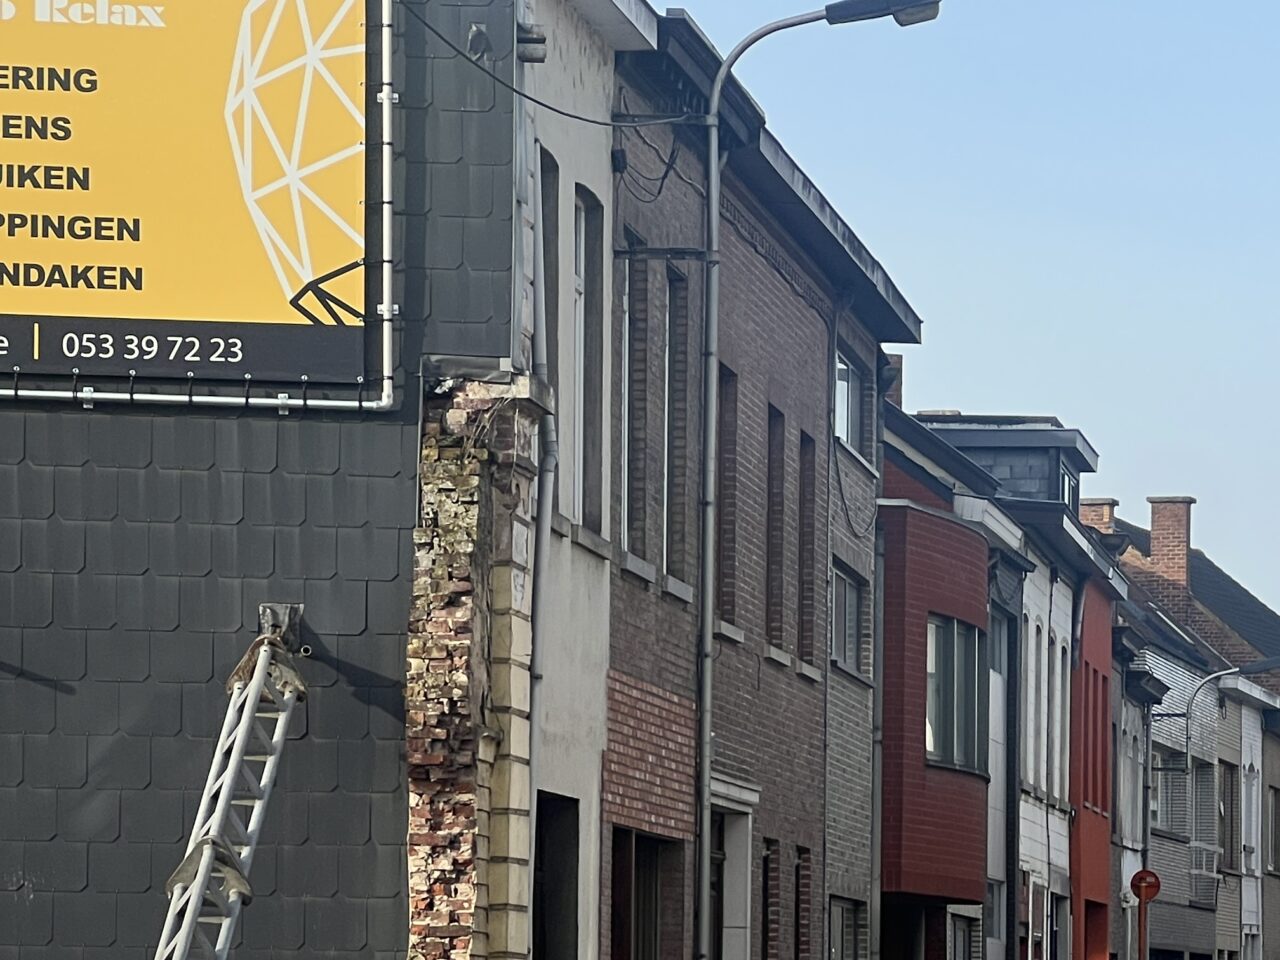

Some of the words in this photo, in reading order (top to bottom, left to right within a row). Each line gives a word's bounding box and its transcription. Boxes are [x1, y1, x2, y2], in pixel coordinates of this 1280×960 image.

[34, 0, 167, 27] Relax
[2, 115, 72, 141] ENS
[0, 213, 141, 242] PINGEN
[0, 262, 143, 291] NDAKEN
[62, 332, 115, 359] 053
[123, 335, 158, 360] 39
[166, 336, 201, 361] 72
[209, 337, 243, 363] 23
